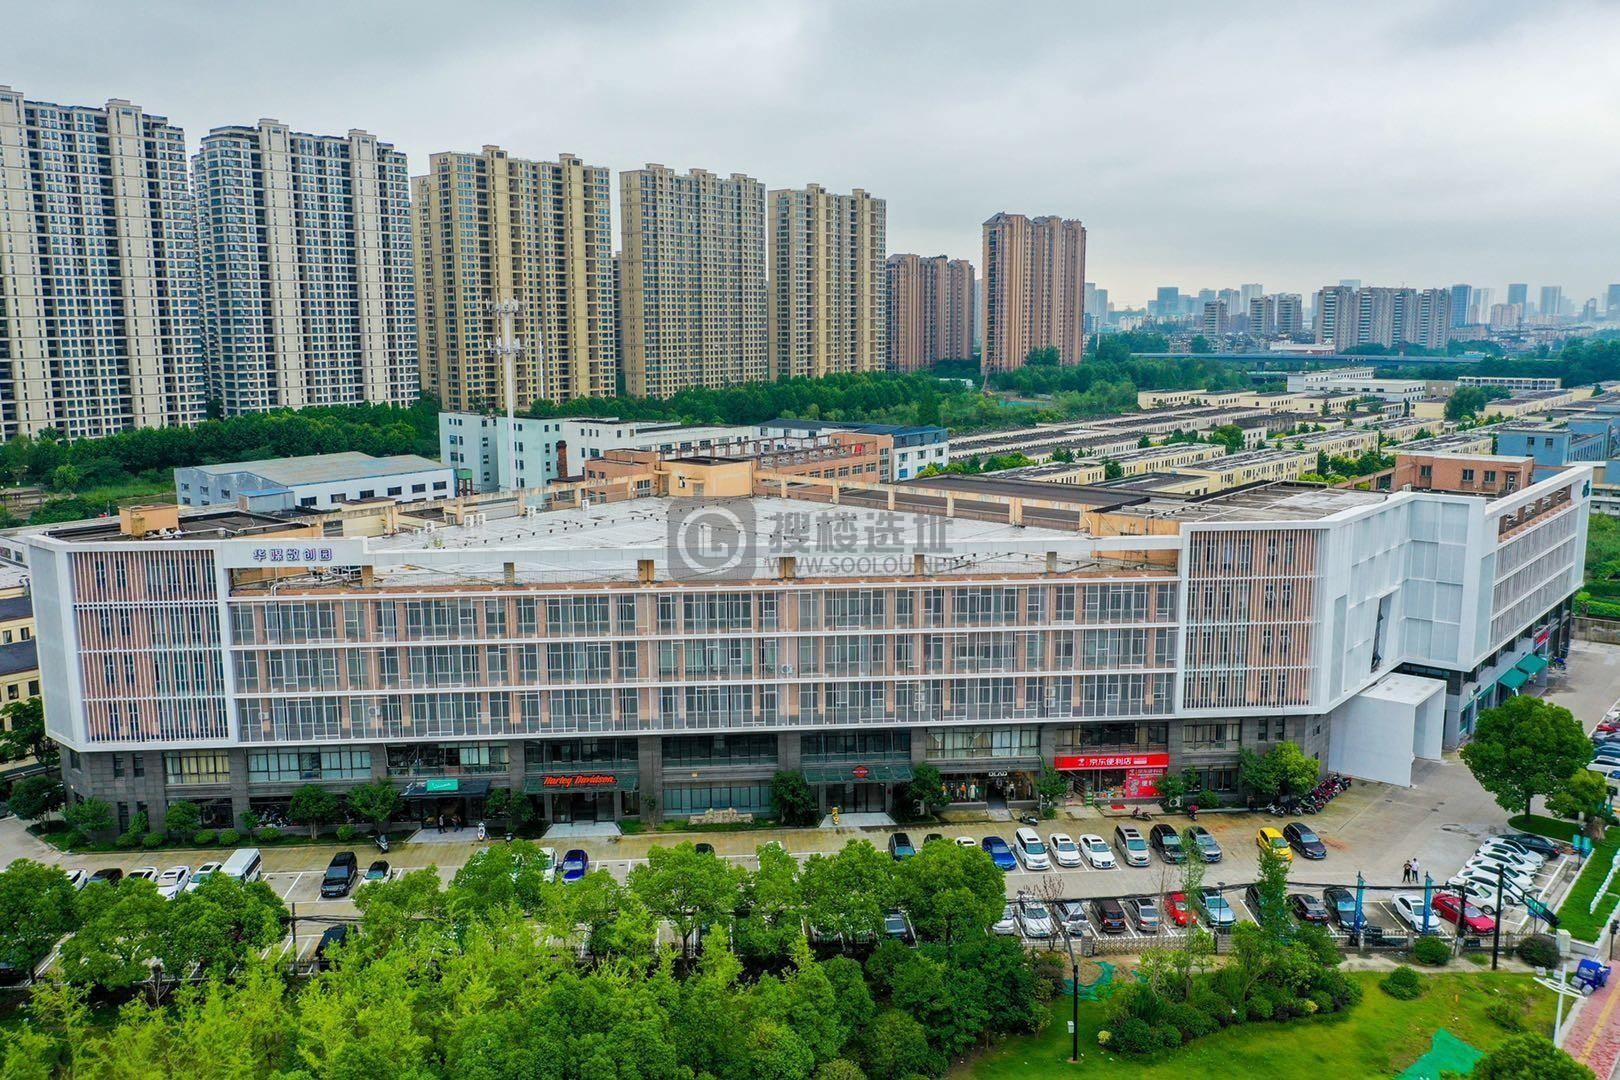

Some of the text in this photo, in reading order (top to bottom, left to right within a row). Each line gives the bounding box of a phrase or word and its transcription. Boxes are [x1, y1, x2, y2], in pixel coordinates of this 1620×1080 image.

[1089, 757, 1132, 766] 京东便利店
